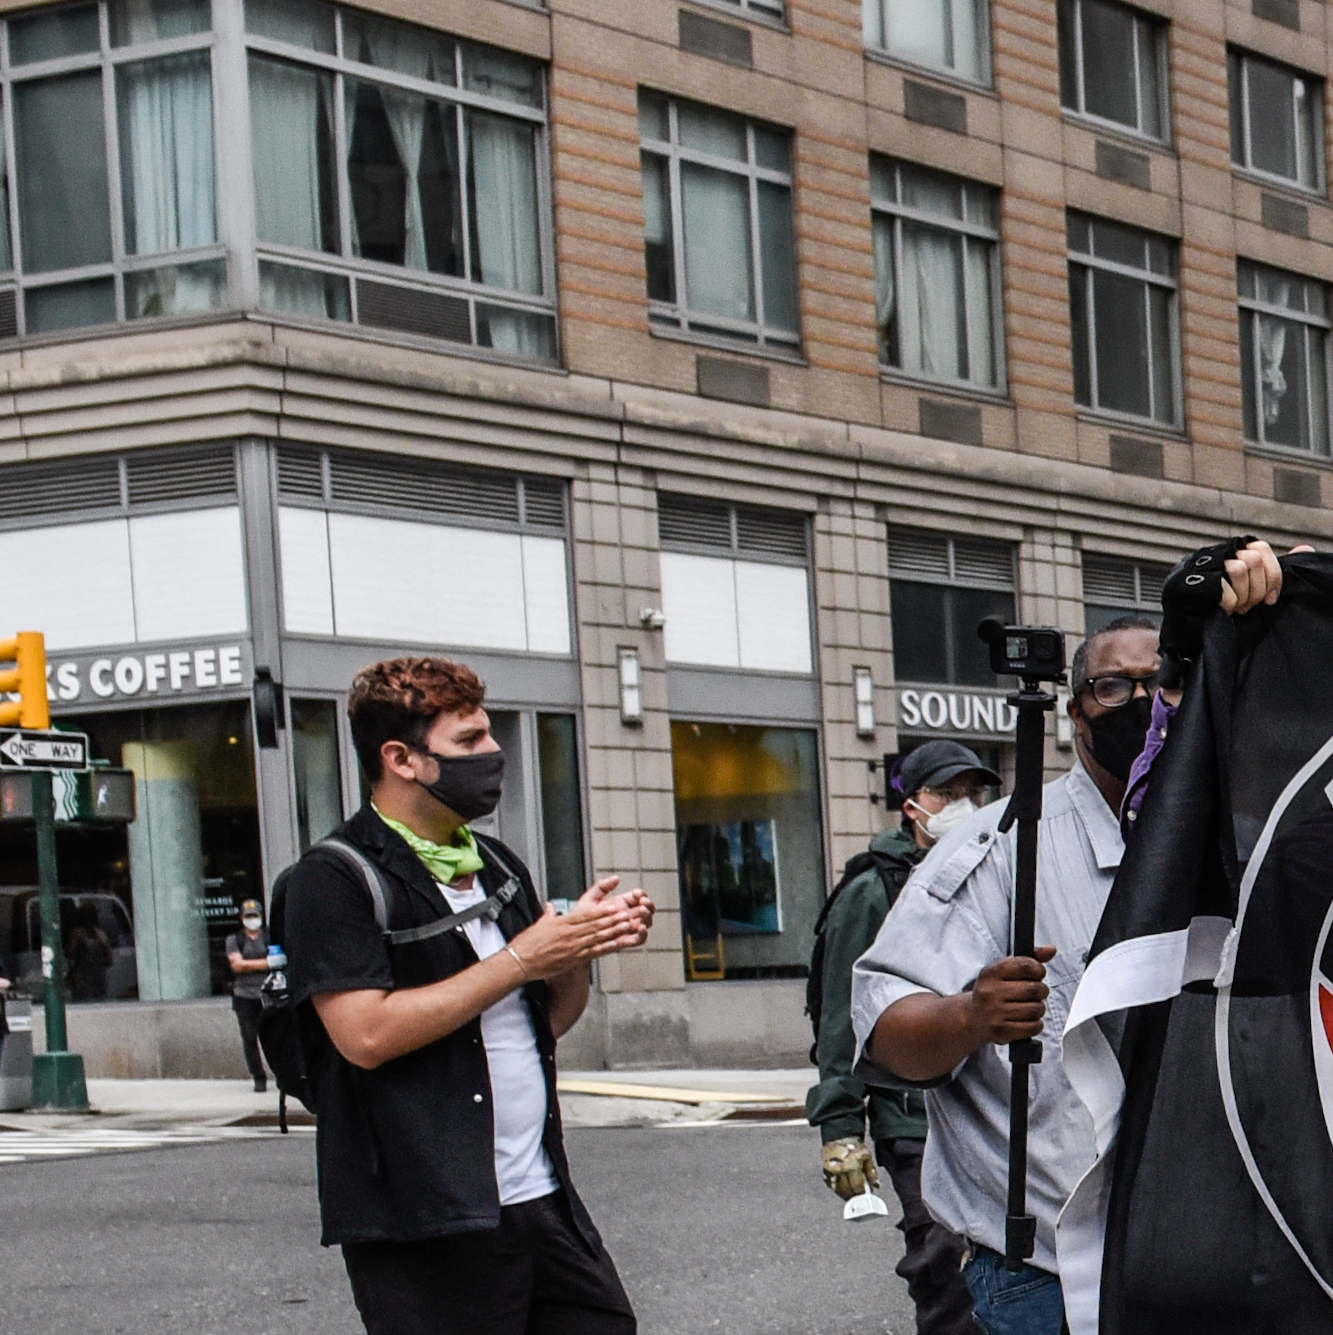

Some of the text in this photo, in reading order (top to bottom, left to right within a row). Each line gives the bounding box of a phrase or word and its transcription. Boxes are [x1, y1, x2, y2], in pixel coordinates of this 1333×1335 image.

[89, 646, 243, 697] COFFEE
[901, 690, 1019, 732] SOUND
[9, 743, 80, 758] ONE WAY
